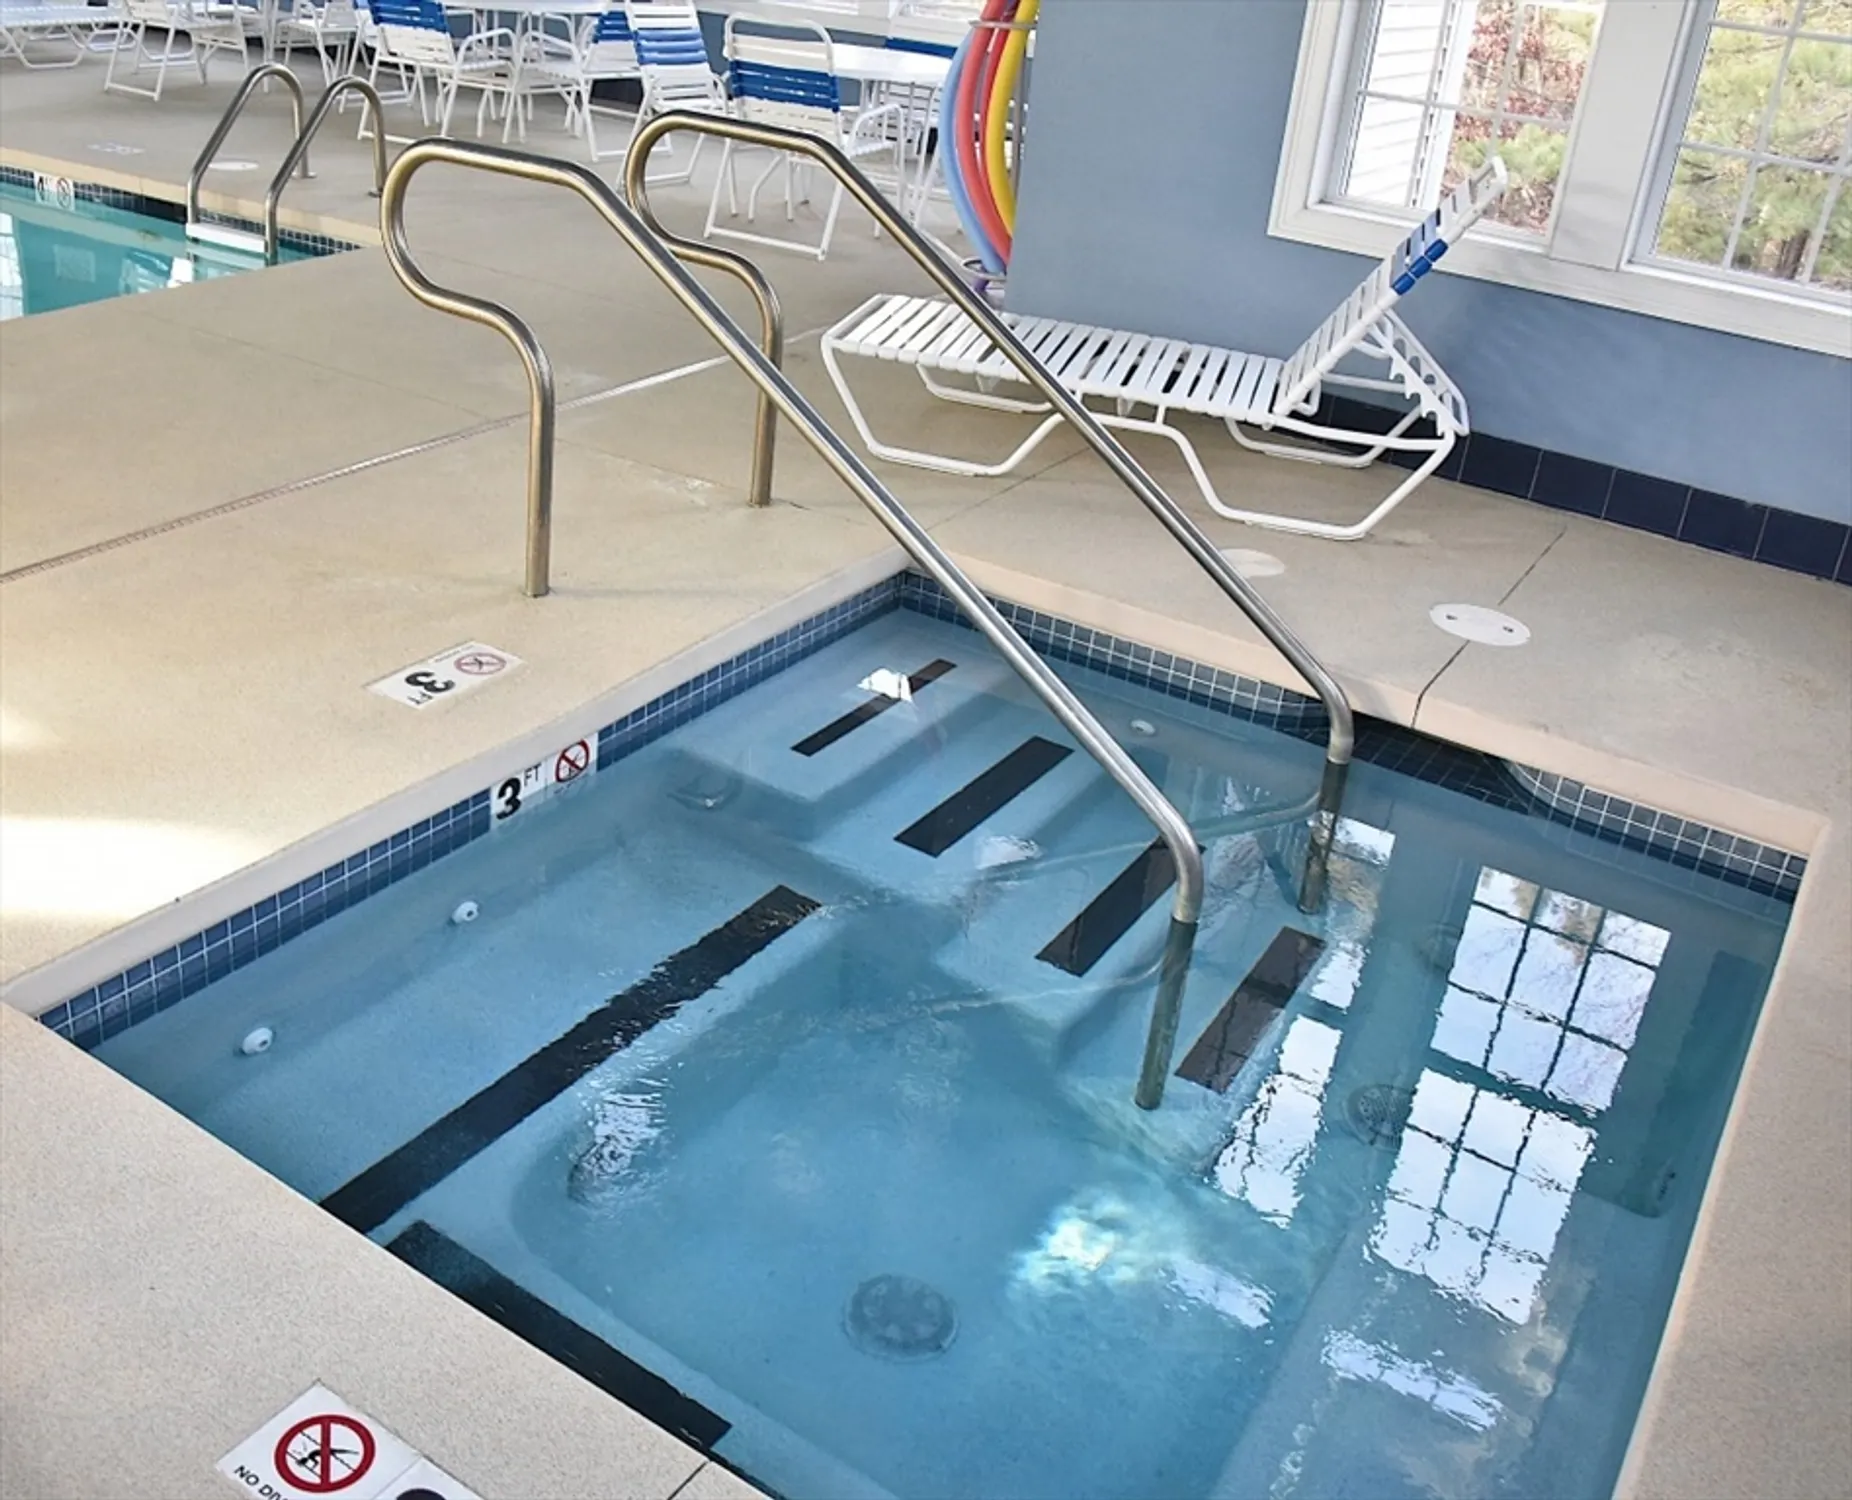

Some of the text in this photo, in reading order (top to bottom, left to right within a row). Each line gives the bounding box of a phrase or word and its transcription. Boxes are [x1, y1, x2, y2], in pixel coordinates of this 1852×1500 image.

[404, 671, 456, 693] 3
[496, 762, 542, 820] 3 FT
[234, 1465, 260, 1486] NO
